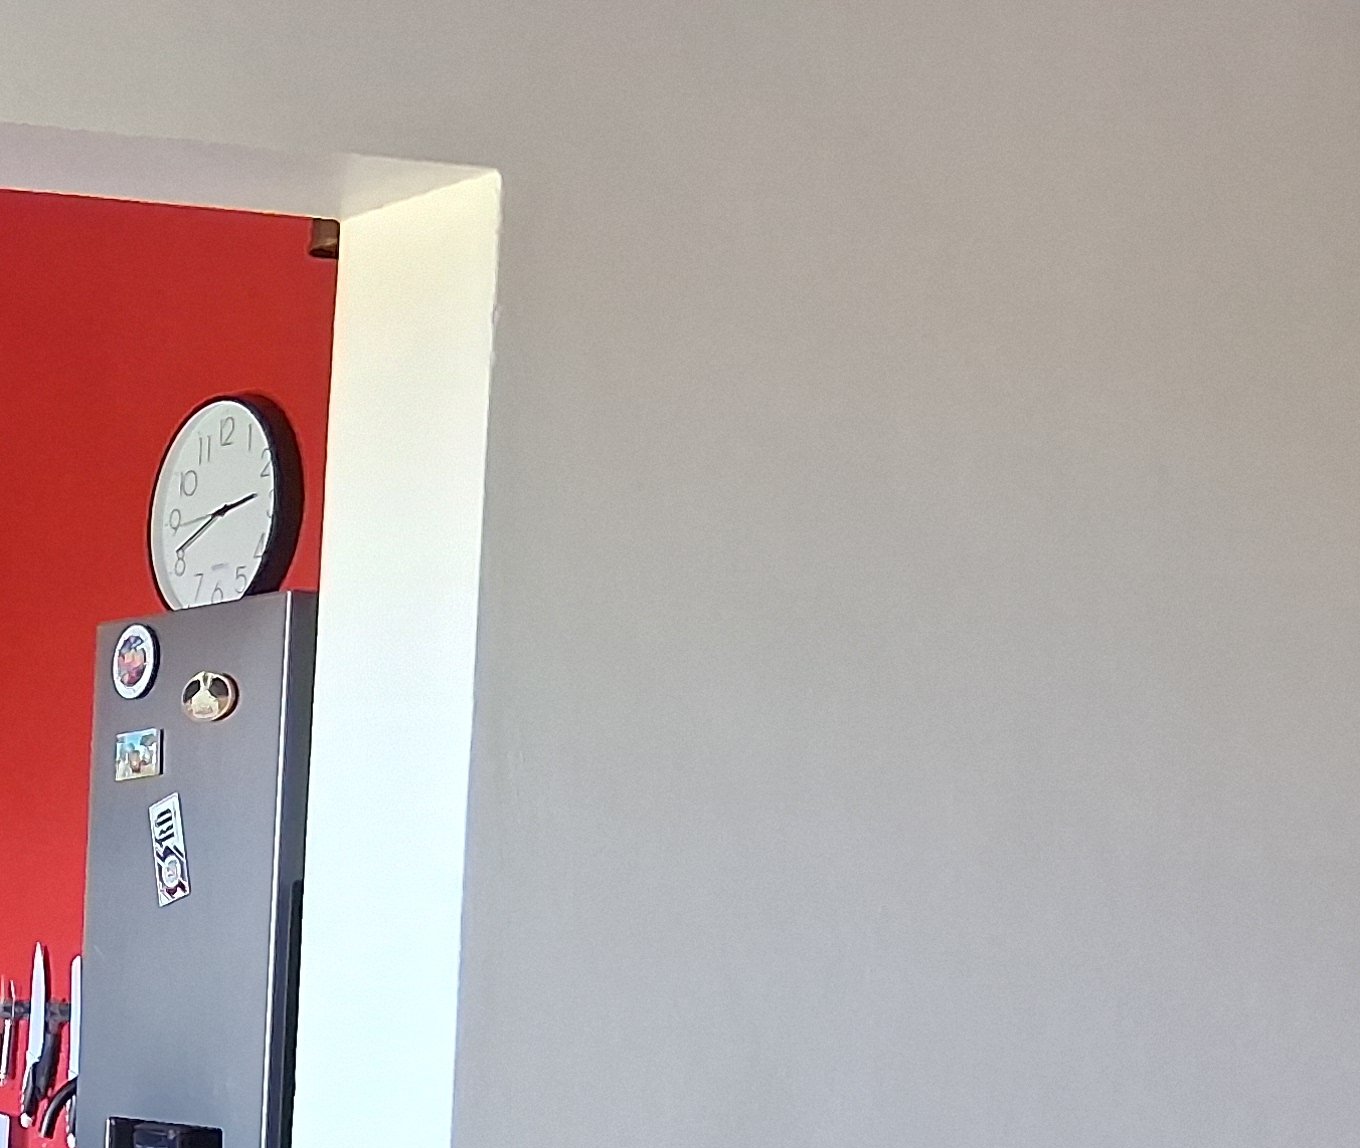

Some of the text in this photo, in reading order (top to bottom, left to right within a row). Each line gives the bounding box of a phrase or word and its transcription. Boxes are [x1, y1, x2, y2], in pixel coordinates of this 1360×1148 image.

[219, 416, 235, 446] 12
[198, 434, 211, 465] 11
[260, 448, 271, 477] 2
[179, 470, 198, 496] 10
[169, 508, 181, 535] 9
[175, 550, 186, 576] 8
[194, 573, 204, 605] 7
[211, 582, 224, 604] 6
[234, 566, 248, 594] 5
